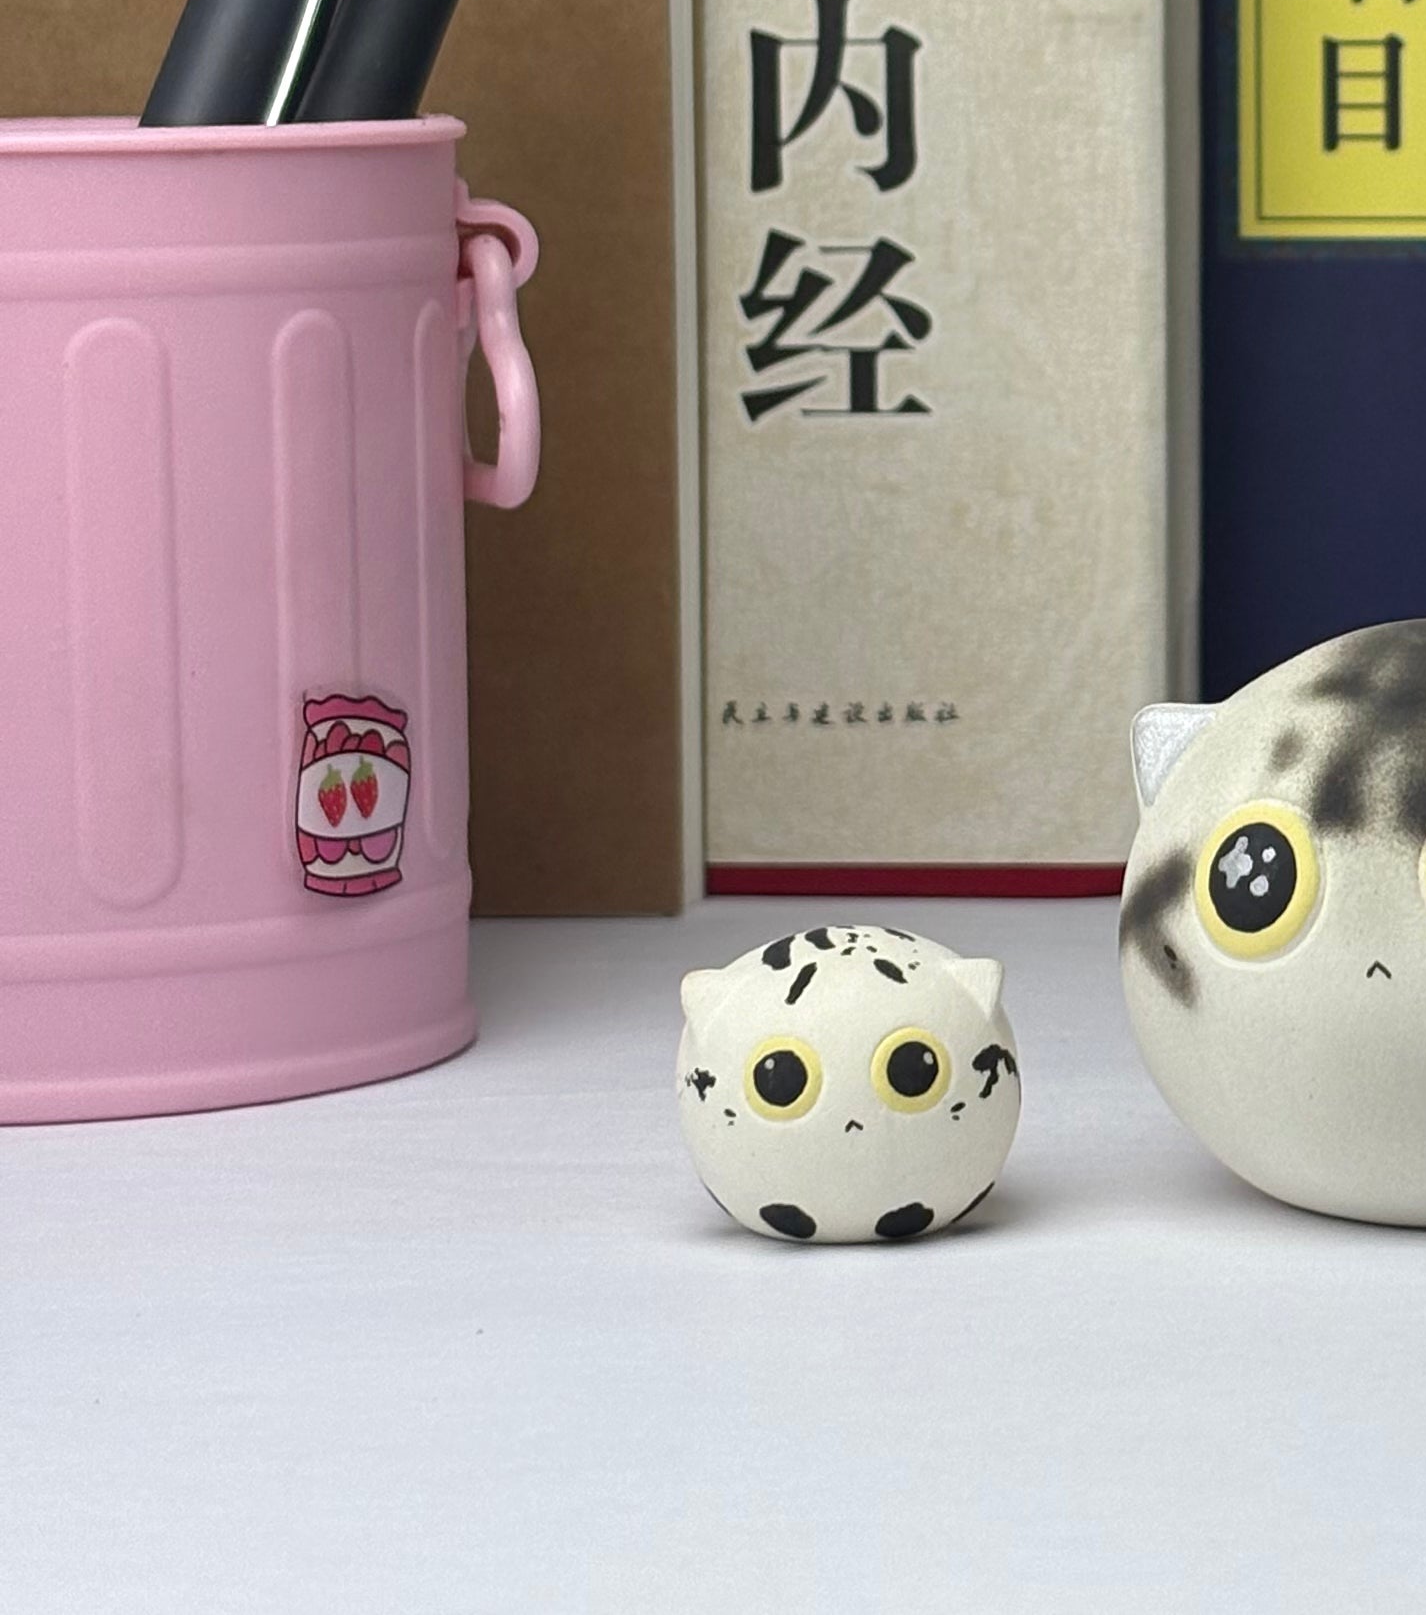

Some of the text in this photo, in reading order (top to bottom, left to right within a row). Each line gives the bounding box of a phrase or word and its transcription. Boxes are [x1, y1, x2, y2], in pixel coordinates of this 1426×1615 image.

[721, 699, 960, 726] 民主与建设出版社
